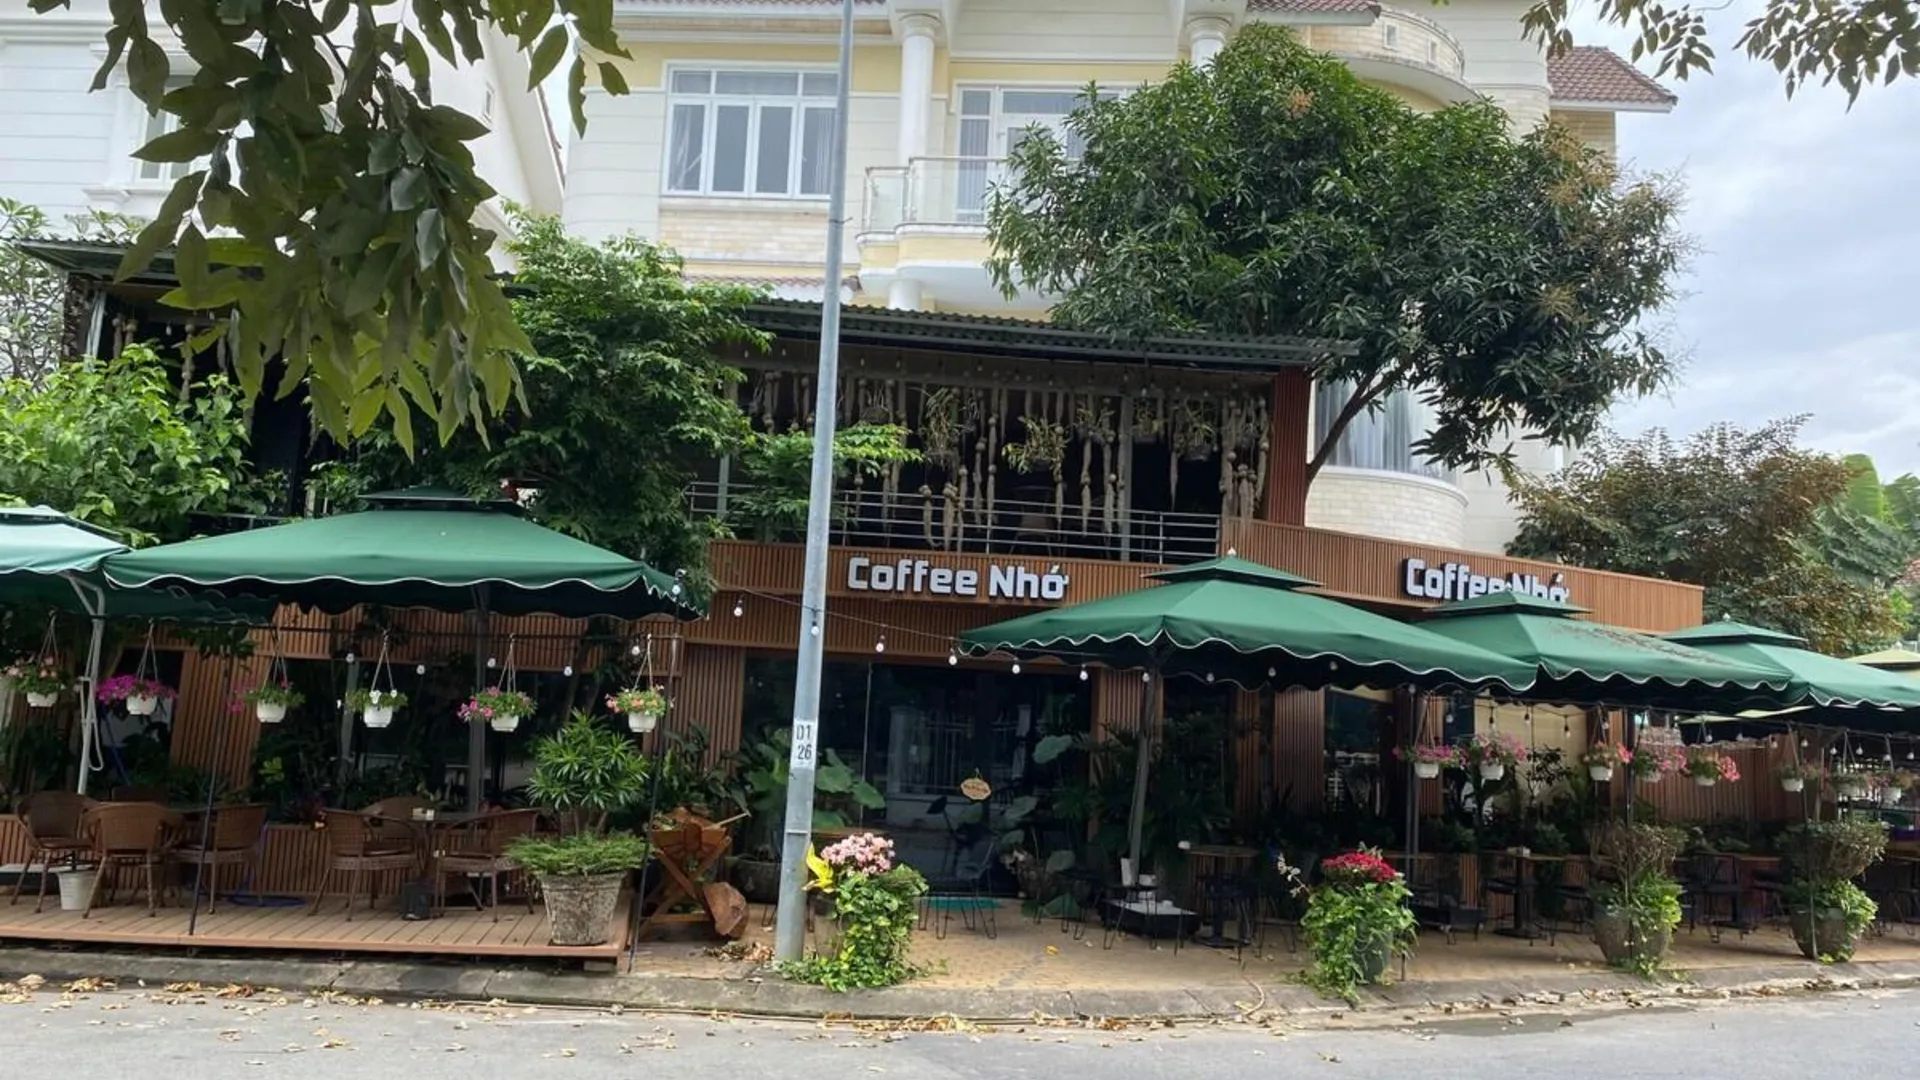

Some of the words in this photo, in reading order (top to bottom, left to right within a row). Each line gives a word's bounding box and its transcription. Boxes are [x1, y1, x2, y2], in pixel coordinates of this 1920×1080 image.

[848, 557, 978, 595] Coffee
[989, 564, 1070, 600] Nhớ
[797, 744, 812, 760] 26
